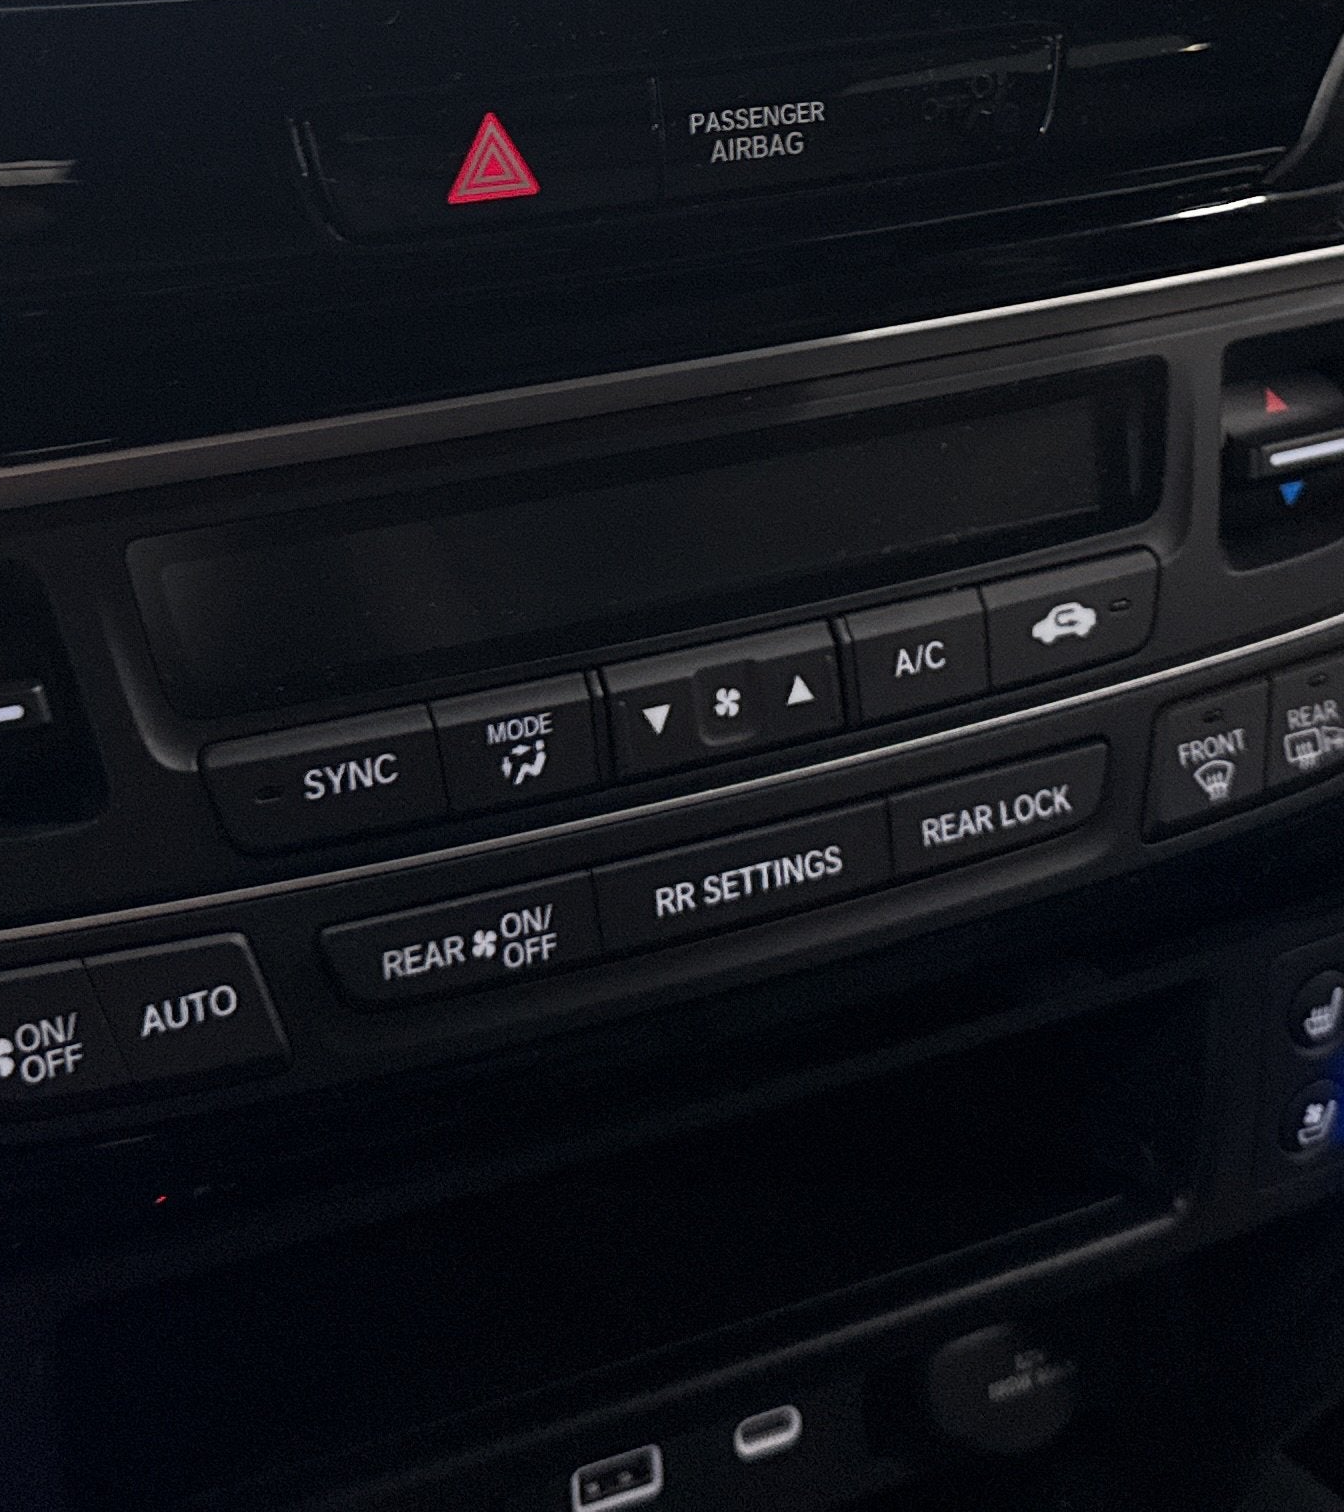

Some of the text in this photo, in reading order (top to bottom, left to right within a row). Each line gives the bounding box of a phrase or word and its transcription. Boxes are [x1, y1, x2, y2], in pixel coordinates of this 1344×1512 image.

[688, 101, 825, 135] PASSENGER
[711, 131, 804, 164] AIRBAG
[893, 641, 946, 676] A/C
[487, 712, 553, 746] MODE
[1286, 699, 1339, 729] REAR
[1177, 728, 1246, 769] FRONT
[303, 753, 399, 801] SYNC
[921, 784, 1072, 847] REAR LOCK
[655, 845, 843, 918] RR SETTINGS
[381, 935, 465, 981] REAR
[502, 931, 558, 969] OFF
[140, 985, 238, 1039] AUTO
[21, 1043, 83, 1084] OFF
